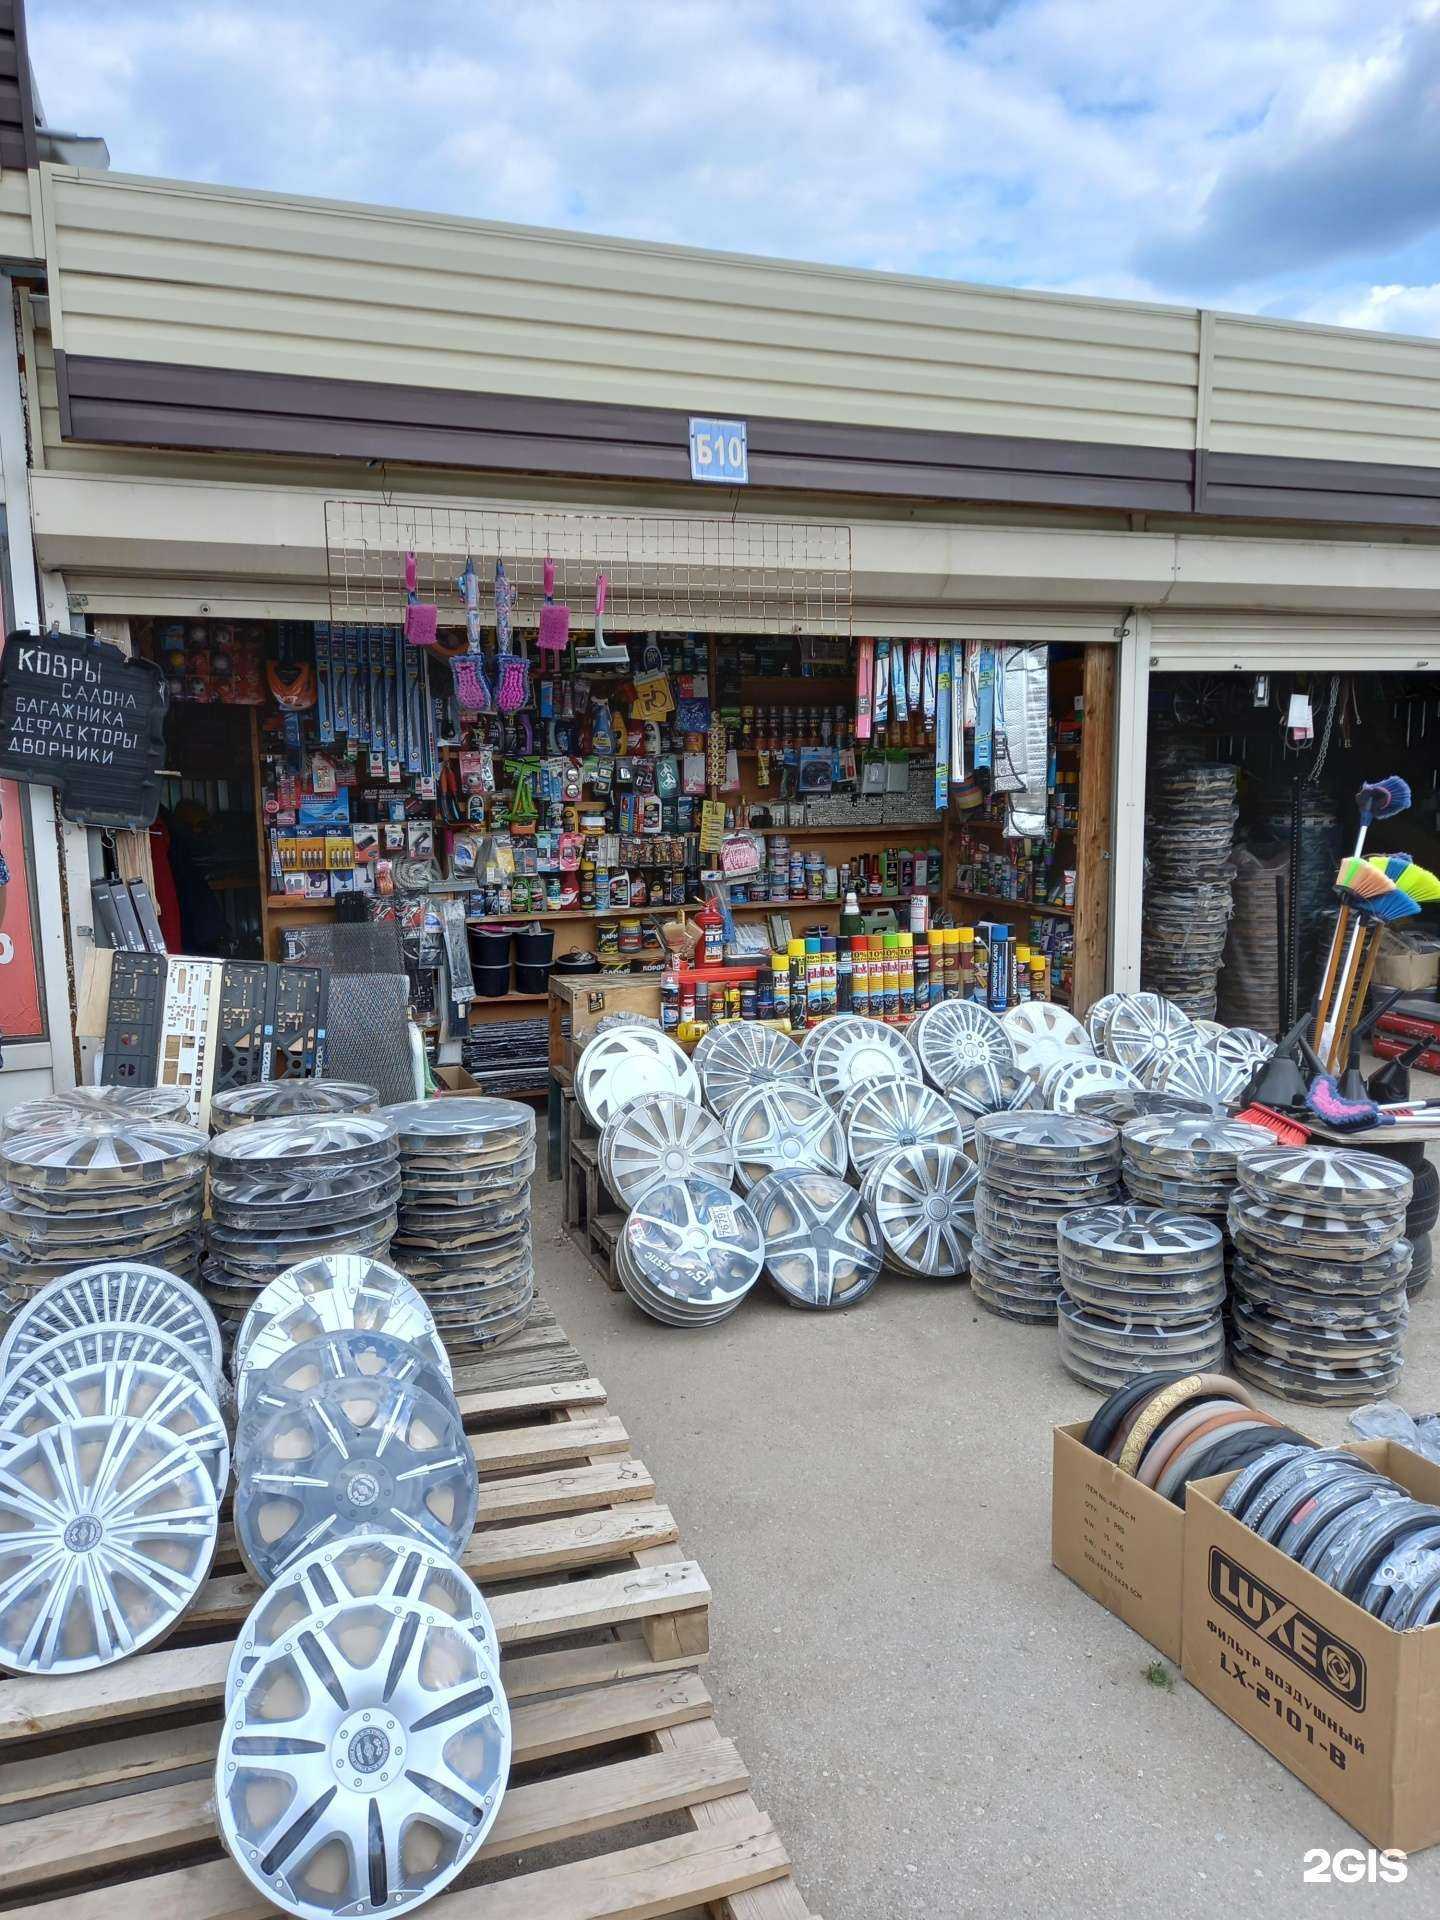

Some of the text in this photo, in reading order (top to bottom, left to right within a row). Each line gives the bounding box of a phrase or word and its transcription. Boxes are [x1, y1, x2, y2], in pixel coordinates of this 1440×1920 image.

[696, 433, 742, 468] Б10
[18, 647, 102, 684] КОВРЫ
[15, 696, 124, 728] БАГАЖНИКА
[61, 683, 136, 709] САЛОНА
[11, 716, 138, 749] ДЕФЛЕКТОРЫ
[8, 737, 113, 764] ДВОРНИКИ
[644, 1251, 673, 1273] JESTIC
[1217, 1561, 1319, 1667] LUXE
[1206, 1616, 1366, 1756] ФИЛЬТР ВОЗДУШНЫЙ
